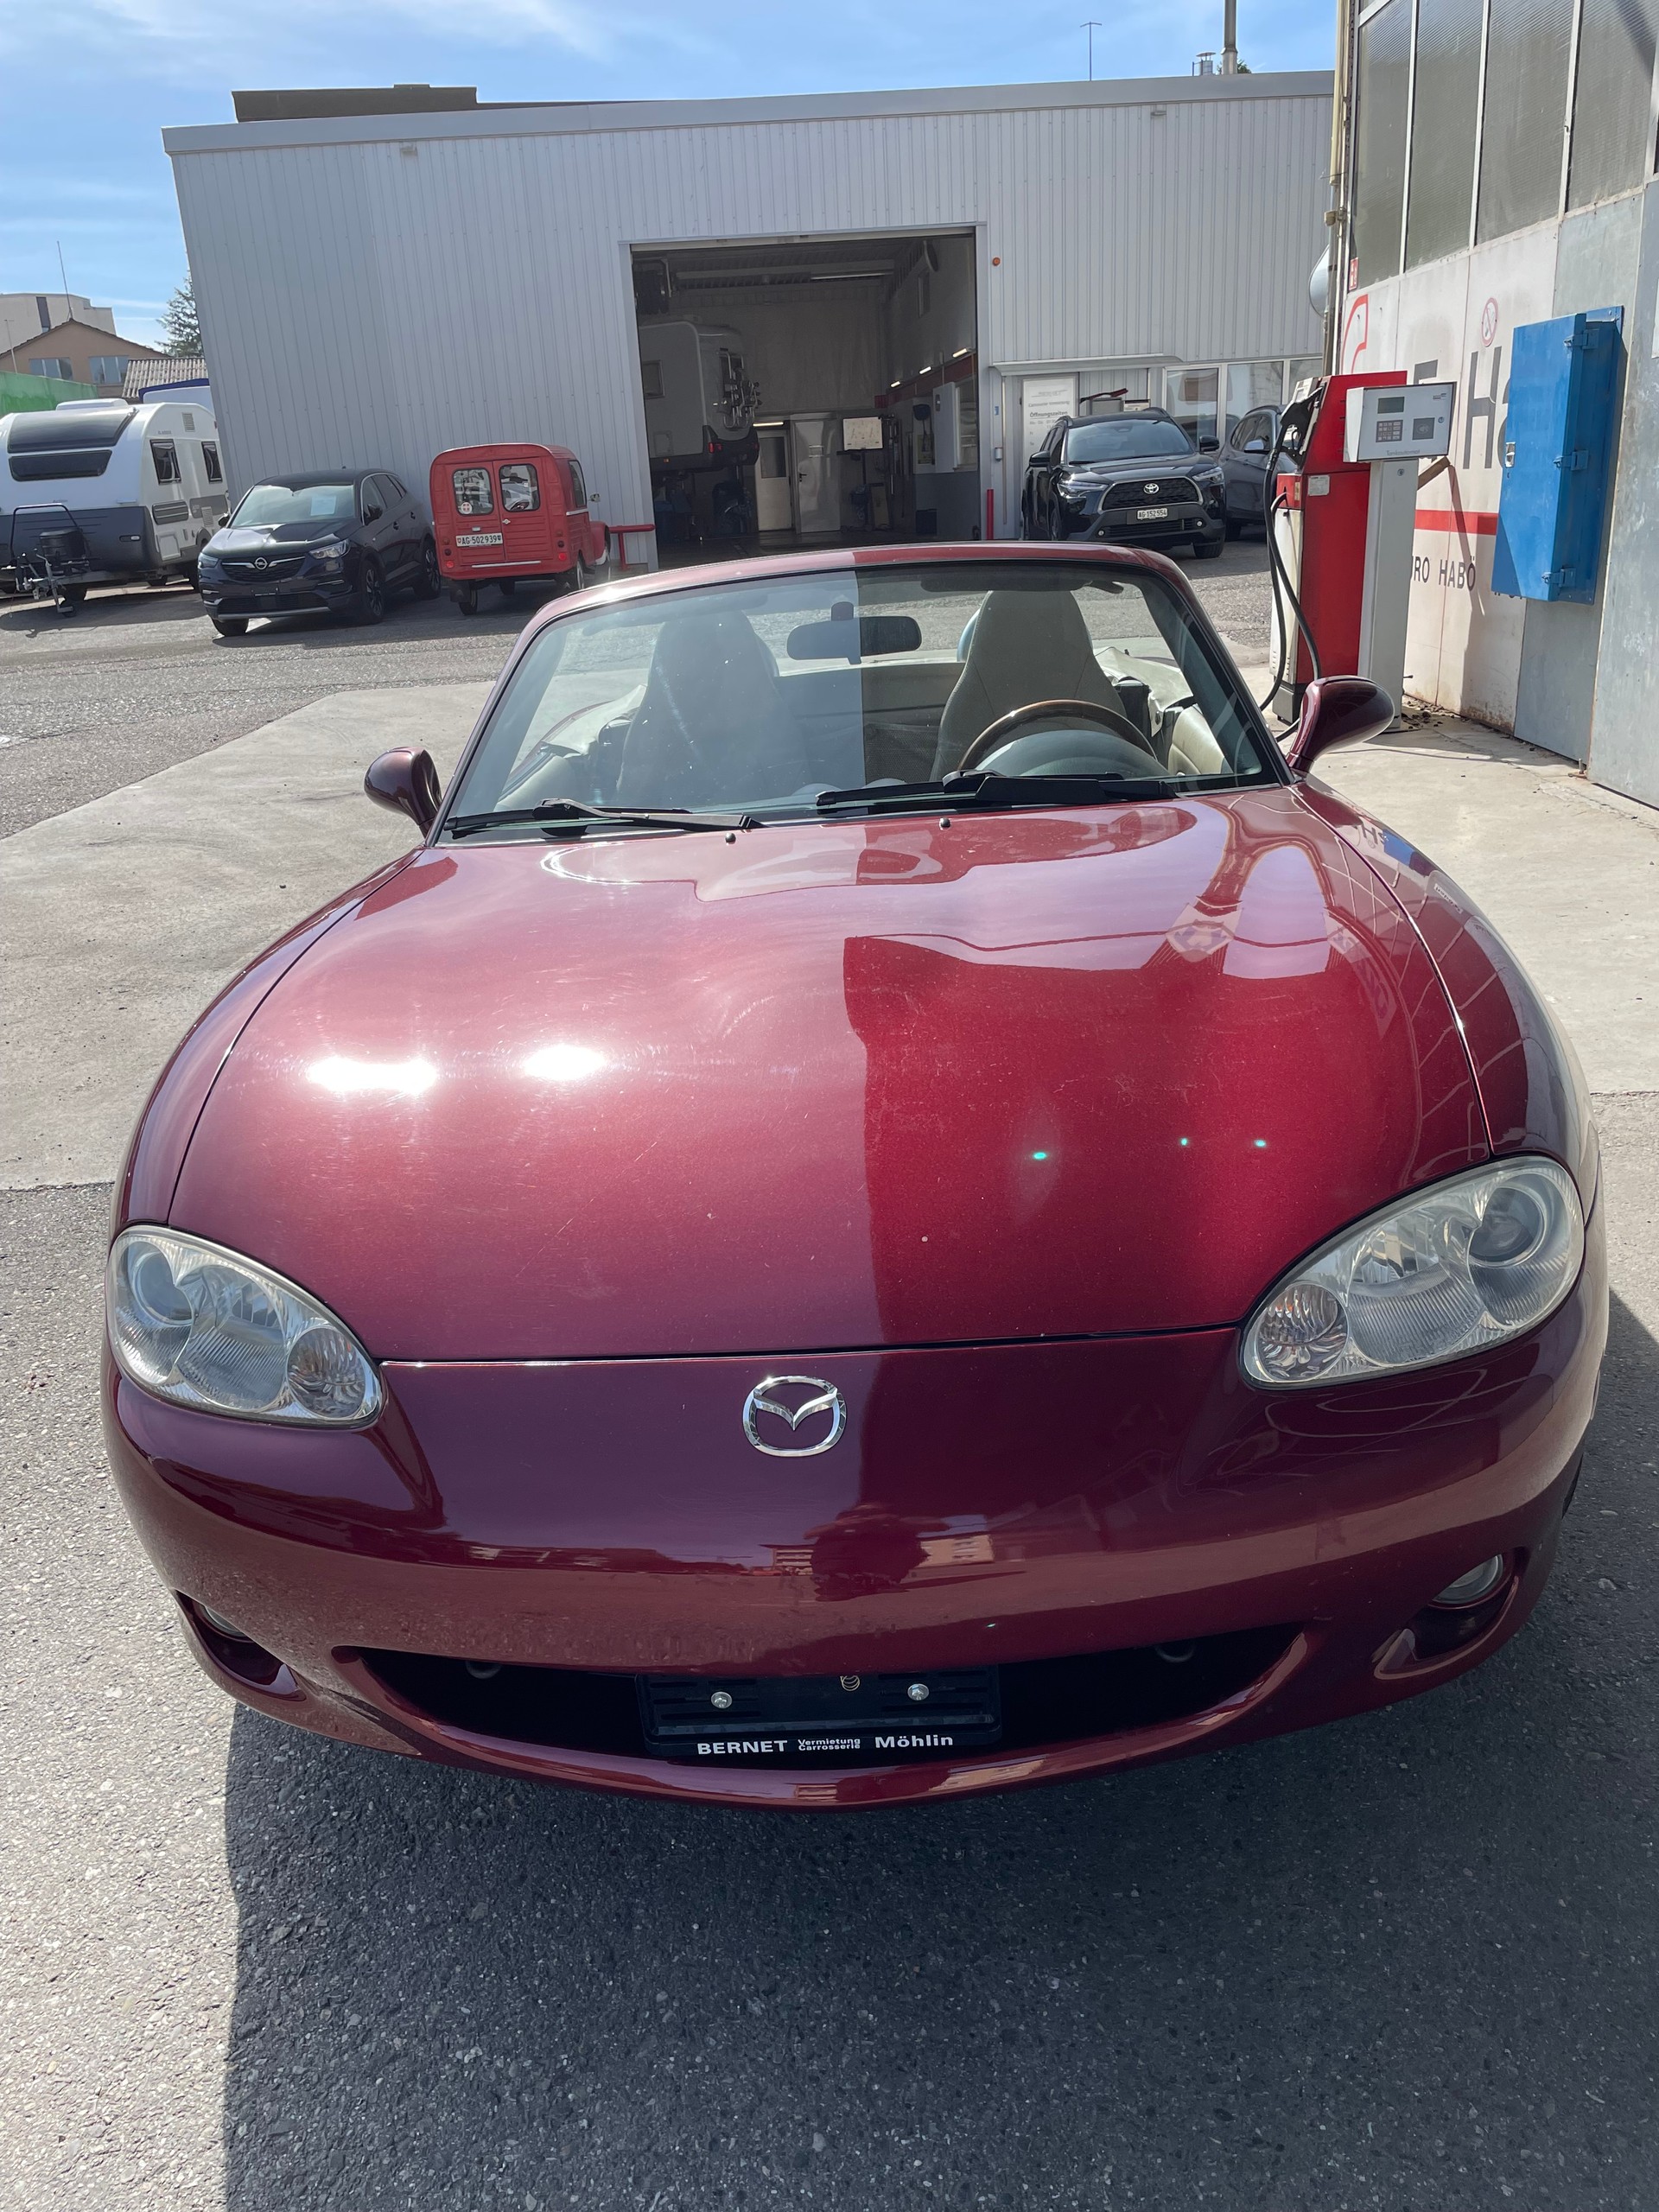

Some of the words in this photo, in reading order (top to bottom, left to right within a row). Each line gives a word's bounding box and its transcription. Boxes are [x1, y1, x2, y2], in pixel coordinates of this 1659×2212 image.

[1412, 556, 1430, 583] RO
[1438, 556, 1476, 591] HABÖ
[697, 1739, 788, 1755] BERNET
[874, 1734, 953, 1748] Möhlin
